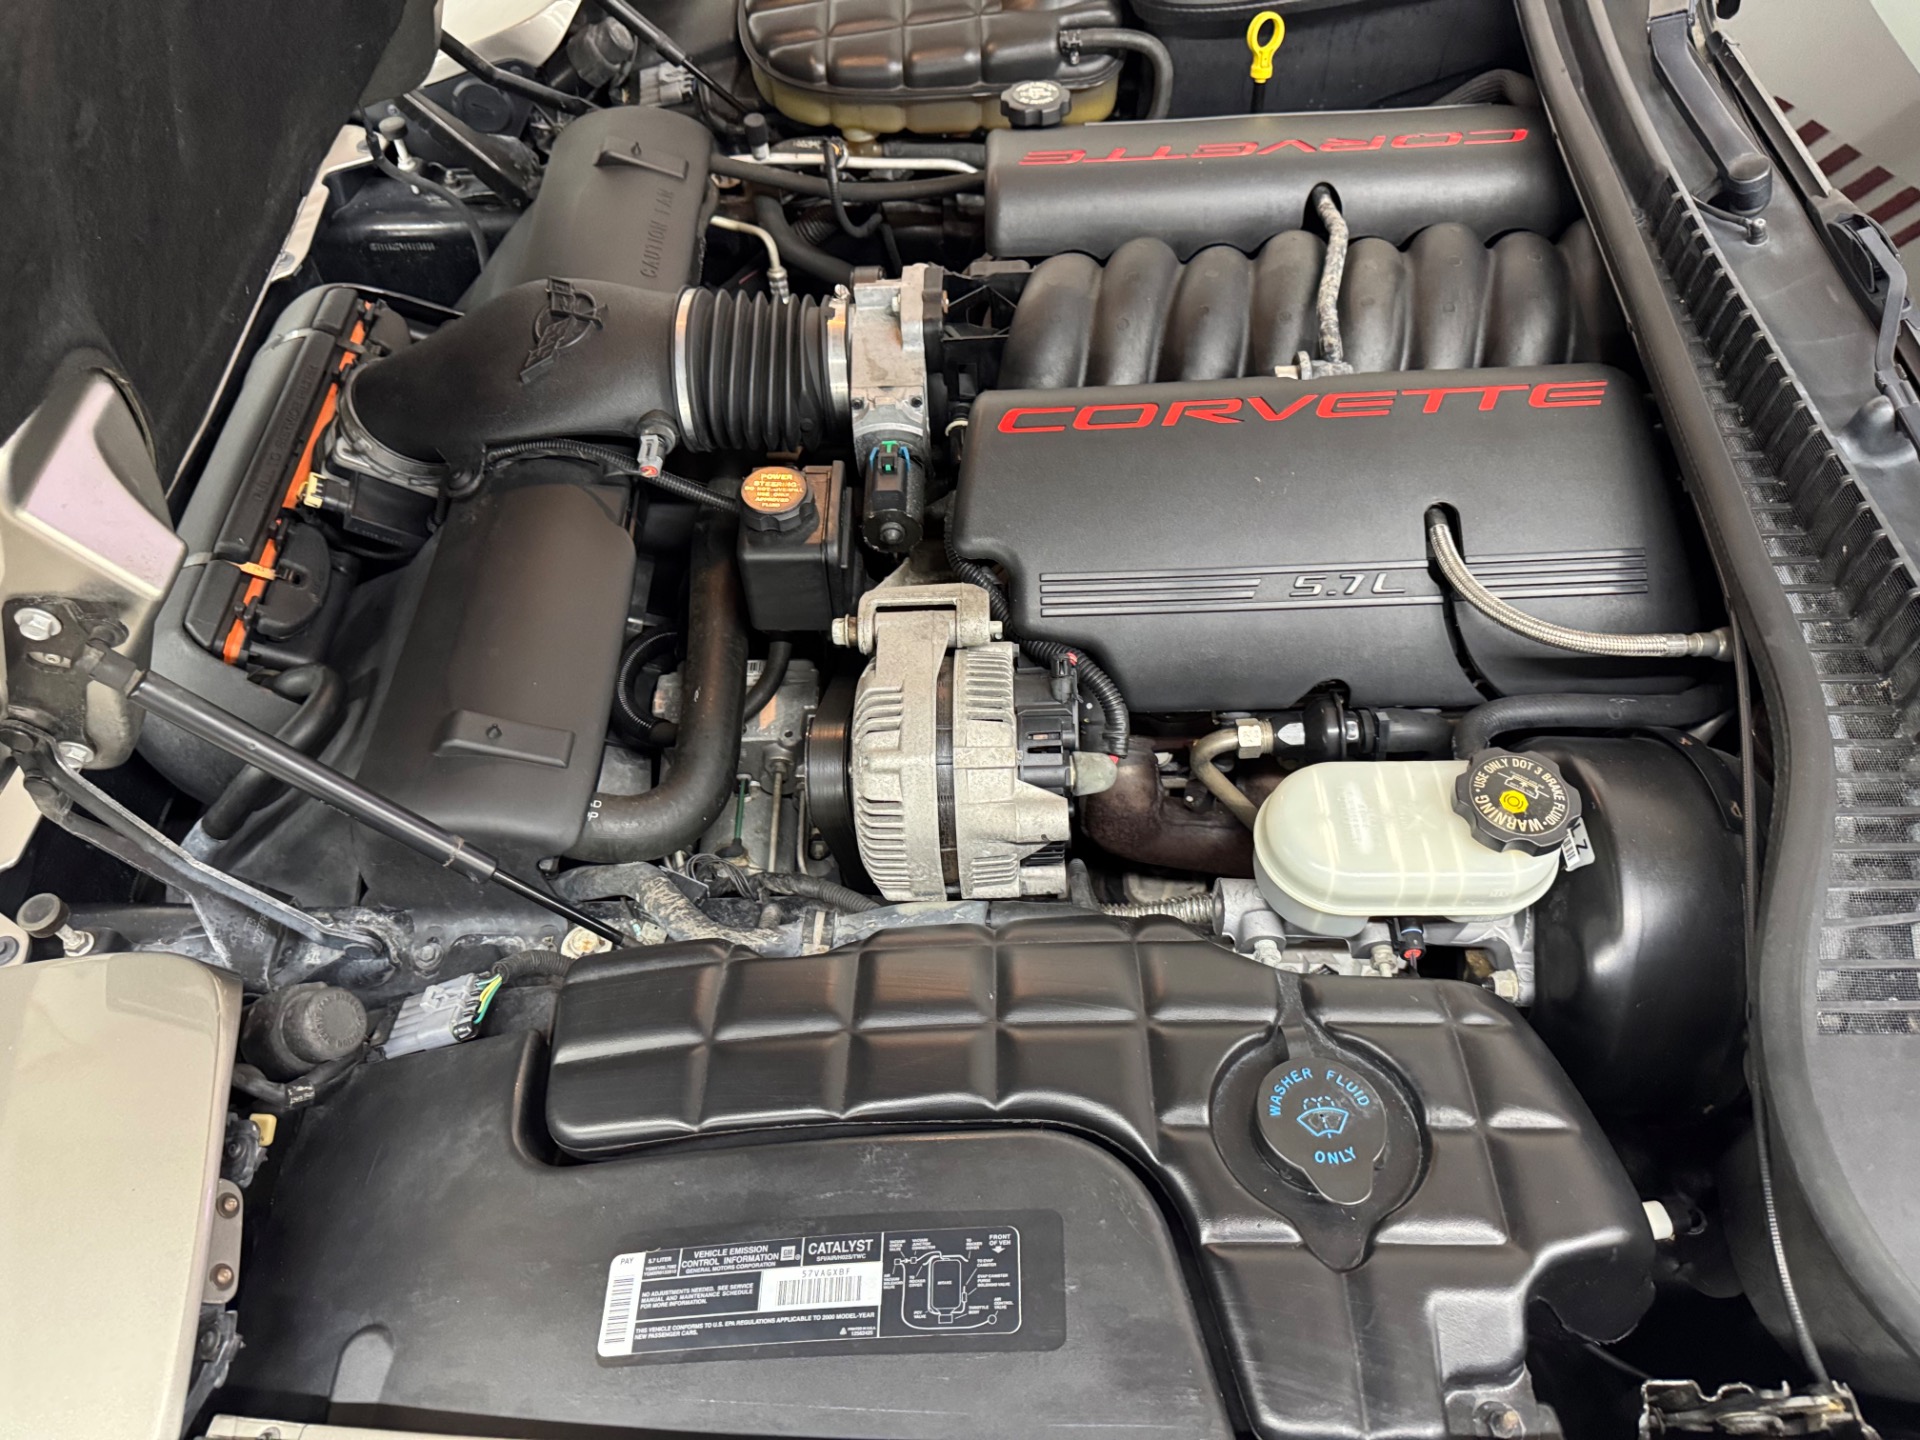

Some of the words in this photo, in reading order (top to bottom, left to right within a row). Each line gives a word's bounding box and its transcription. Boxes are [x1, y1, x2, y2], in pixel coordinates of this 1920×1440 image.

[1018, 128, 1530, 166] CORVETTE
[998, 380, 1608, 434] CORVETTE
[1289, 572, 1406, 598] 5.7L
[1484, 758, 1509, 774] ONLY
[1512, 758, 1534, 770] DOT
[1534, 766, 1544, 775] 3
[1474, 771, 1490, 789] USE
[1542, 773, 1566, 801] BRAKE
[1475, 794, 1544, 832] WARNING
[1546, 802, 1566, 826] FLUID
[1269, 1068, 1313, 1116] WASHER
[1326, 1070, 1370, 1106] FLUID
[1314, 1146, 1356, 1164] ONLY
[694, 1249, 728, 1258] VEHICLE
[729, 1245, 769, 1256] EMISSION
[808, 1239, 874, 1255] CATALYST
[682, 1258, 719, 1268] CONTROL
[724, 1253, 779, 1264] INFORMATION
[686, 1266, 711, 1274] GENERAL
[736, 1262, 776, 1270] CORPORATION
[651, 1288, 690, 1296] ADJUSTMENTS
[679, 1291, 720, 1300] MAINTENANCE
[672, 1323, 703, 1331] CONFORMS
[736, 1317, 775, 1326] REGULATIONS
[776, 1315, 812, 1324] APPLICABLE
[836, 1312, 875, 1320] MODEL-YEAR
